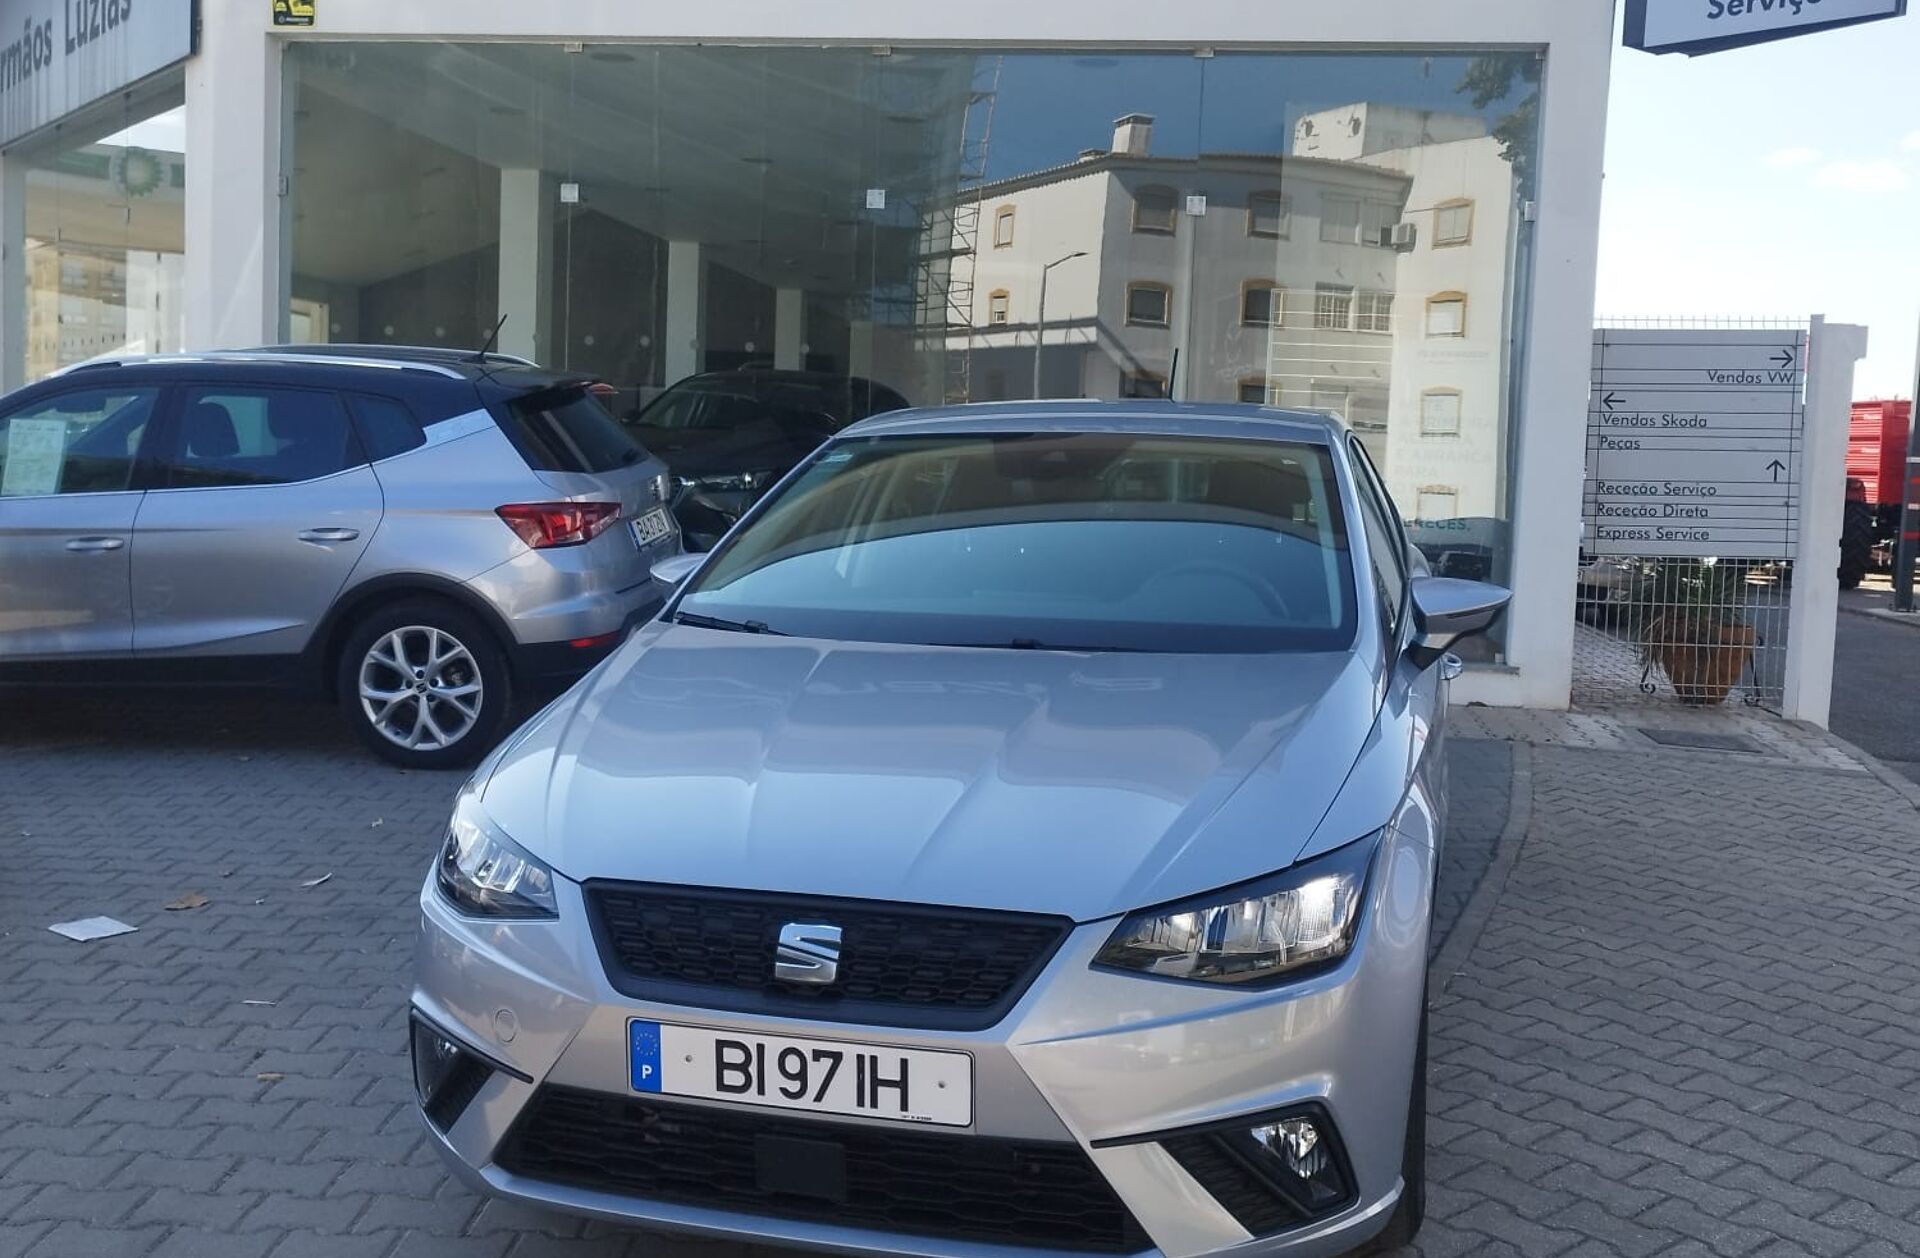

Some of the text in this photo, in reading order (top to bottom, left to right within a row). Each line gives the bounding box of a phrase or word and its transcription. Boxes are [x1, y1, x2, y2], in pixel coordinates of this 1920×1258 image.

[1707, 0, 1821, 19] Serviç
[1707, 370, 1795, 384] Vendas VW
[1602, 413, 1707, 428] Vendas Skoda
[1600, 436, 1641, 452] Peças
[1598, 481, 1717, 498] Receção Serviço
[1597, 502, 1709, 518] Receção Direta
[1596, 526, 1710, 542] Express Service
[641, 1064, 652, 1080] P
[777, 1047, 844, 1103] 97
